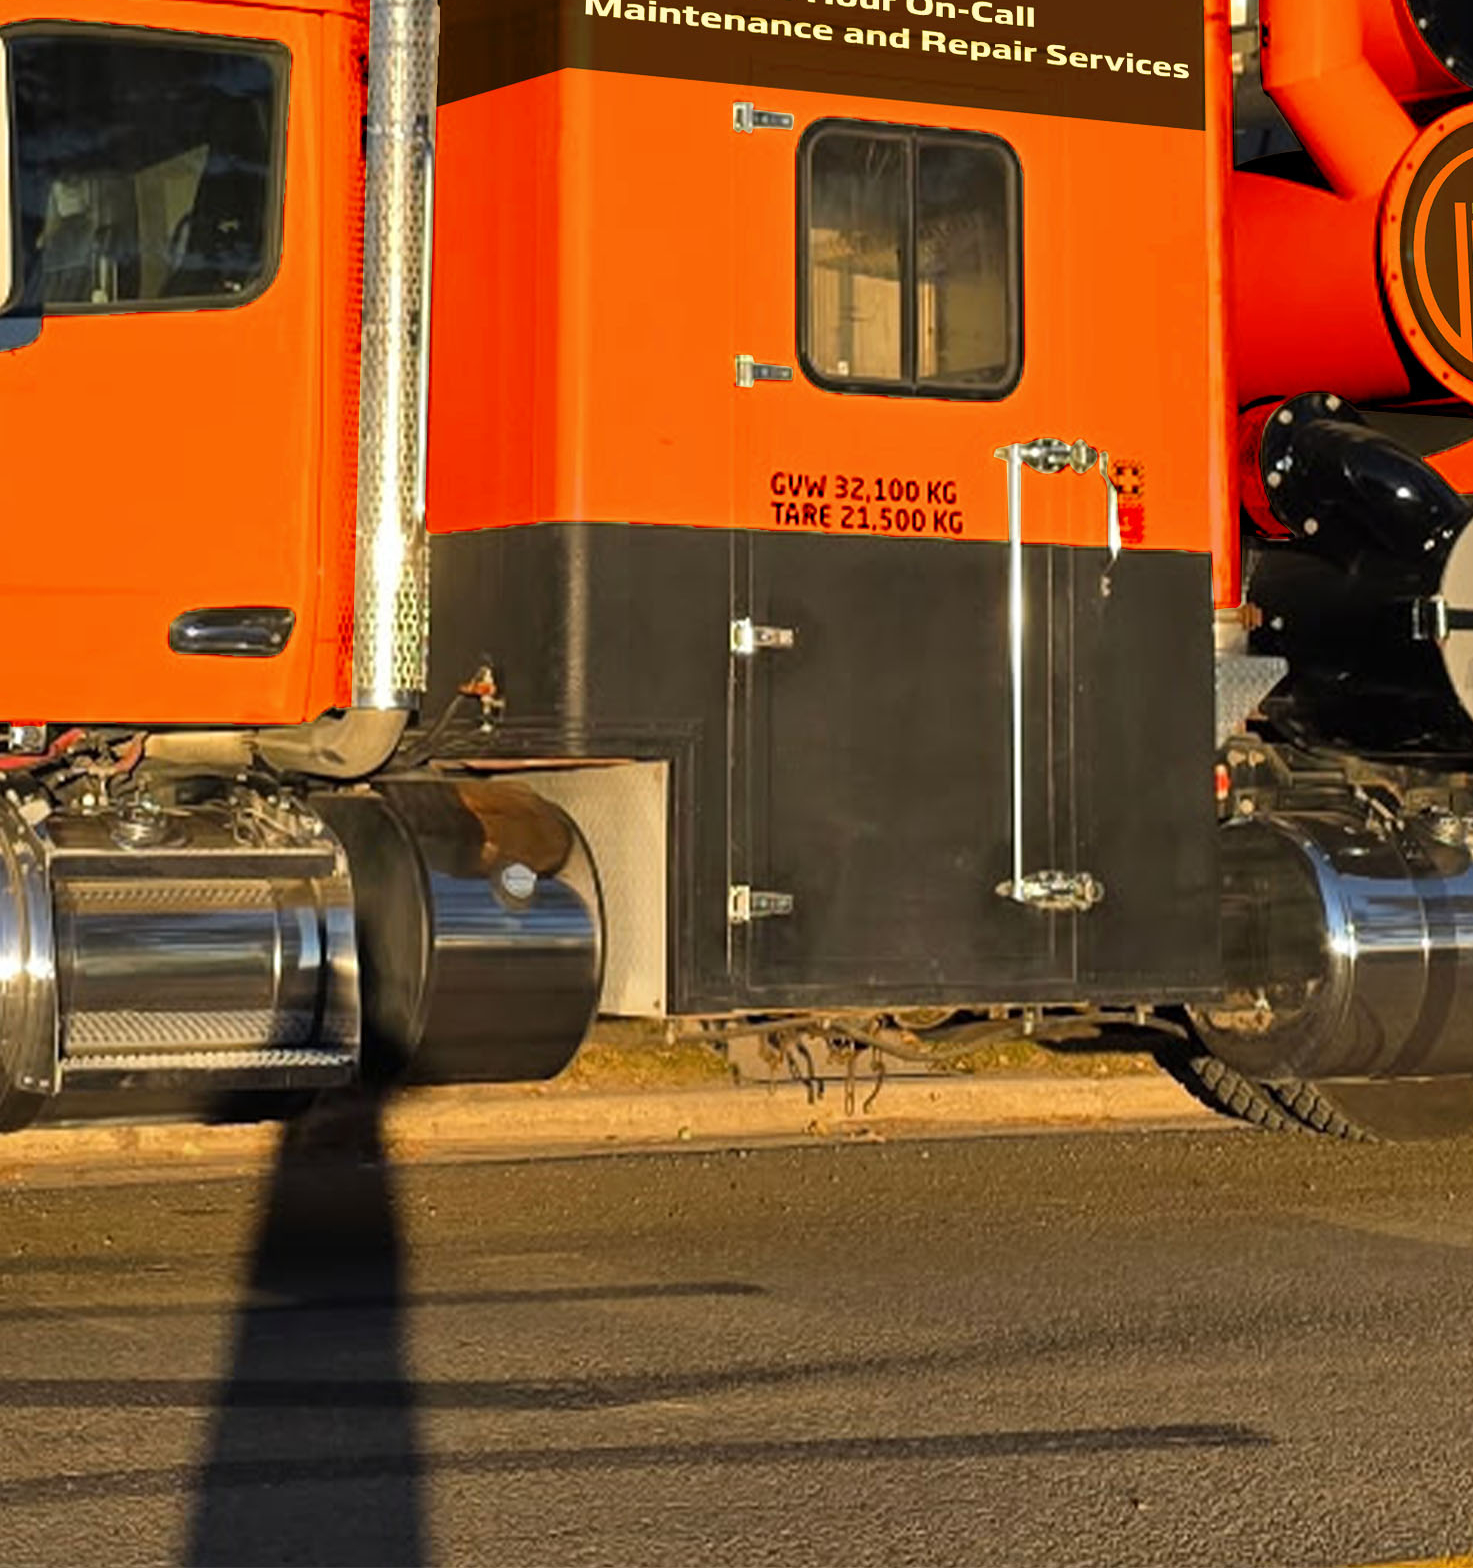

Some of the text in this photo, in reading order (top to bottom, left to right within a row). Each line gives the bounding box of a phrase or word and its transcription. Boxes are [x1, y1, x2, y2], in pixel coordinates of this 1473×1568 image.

[843, 26, 910, 50] and
[921, 30, 1037, 63] Repair
[1046, 44, 1190, 79] Services
[769, 470, 958, 506] GVW 32,100 KG
[769, 500, 965, 535] TARE 21,500 KG
